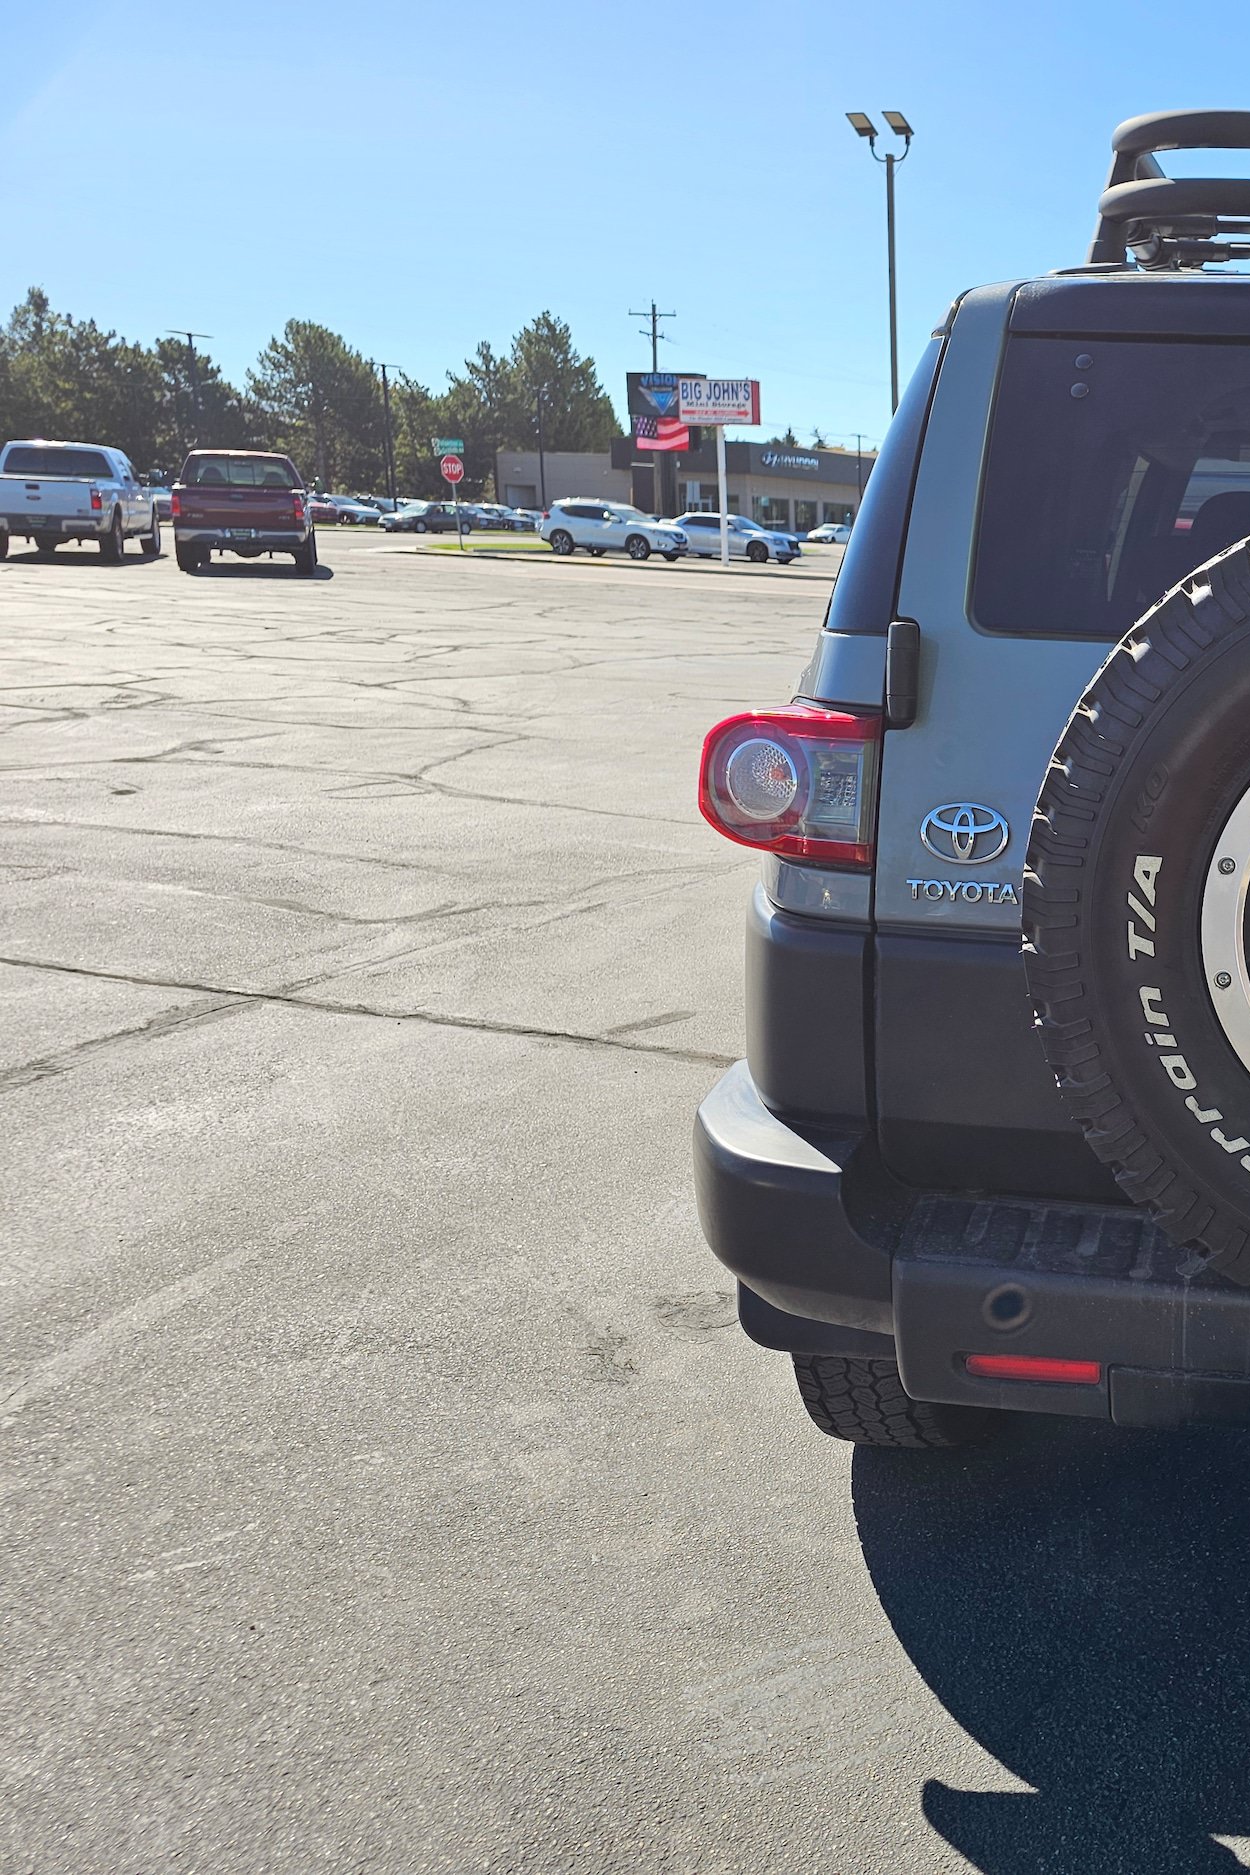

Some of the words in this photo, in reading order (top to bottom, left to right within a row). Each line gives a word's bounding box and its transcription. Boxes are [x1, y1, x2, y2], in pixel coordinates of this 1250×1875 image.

[681, 382, 702, 400] BIG
[706, 382, 751, 401] JOHN'S
[443, 463, 463, 474] STOP
[906, 879, 1018, 905] TOYOTA
[1127, 855, 1163, 961] T/A
